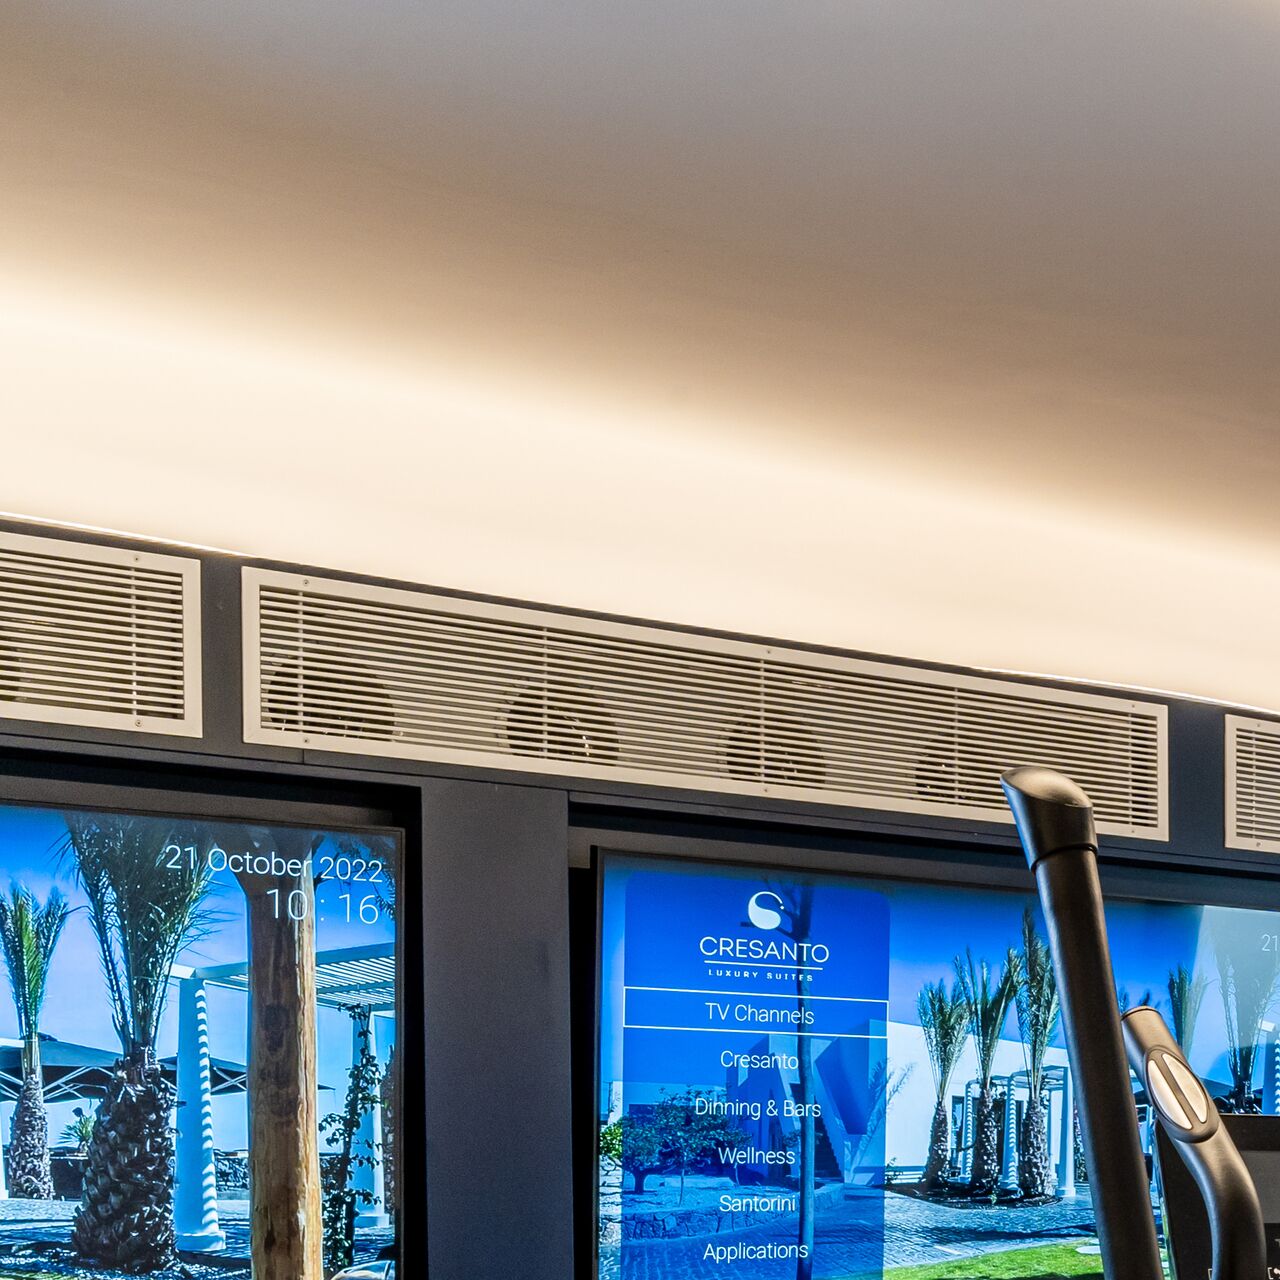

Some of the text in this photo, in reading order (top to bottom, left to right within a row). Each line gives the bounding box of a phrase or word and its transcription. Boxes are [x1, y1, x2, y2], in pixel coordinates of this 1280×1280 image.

[166, 845, 383, 883] 21 October 2022
[266, 889, 307, 921] 10
[338, 893, 380, 924] 16
[700, 936, 830, 963] CRESANTO
[1262, 934, 1278, 952] 21
[709, 969, 813, 982] LUXURY SUITES
[705, 1002, 814, 1025] TV Channels
[720, 1050, 799, 1070] Cresanto
[695, 1098, 821, 1121] Dinning & Bars
[718, 1147, 795, 1165] Wellness
[719, 1195, 796, 1213] Santorini
[703, 1242, 808, 1264] Applications
